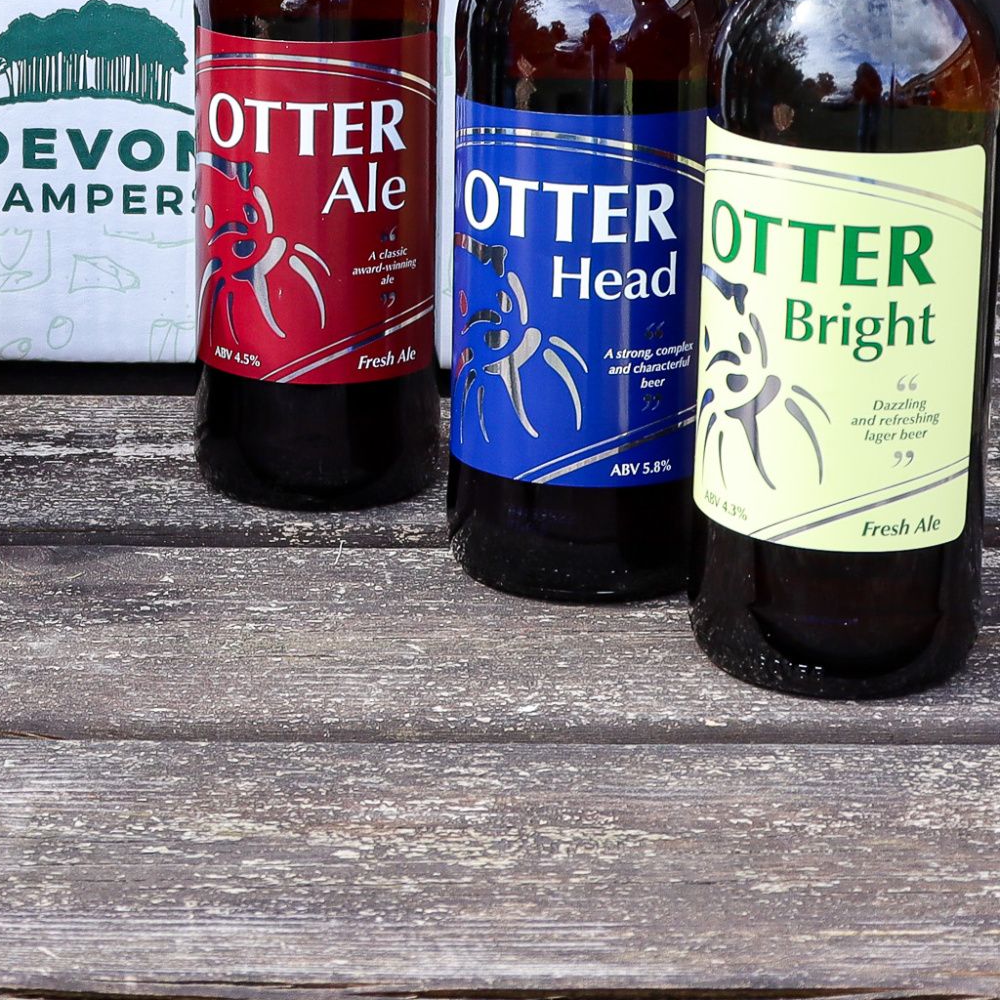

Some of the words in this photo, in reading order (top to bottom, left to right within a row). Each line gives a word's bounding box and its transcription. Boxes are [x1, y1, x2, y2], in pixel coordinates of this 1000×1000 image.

[208, 92, 407, 157] OTTER
[321, 161, 407, 216] Ale
[463, 168, 678, 245] OTTER
[368, 251, 376, 261] A
[379, 246, 408, 260] classic
[711, 199, 936, 287] OTTER
[352, 258, 417, 276] award-winning
[552, 251, 678, 301] Head
[380, 274, 395, 285] ale
[784, 297, 936, 362] Bright
[214, 345, 233, 360] ABV
[234, 351, 261, 367] 4.5%
[357, 350, 394, 370] Fresh
[397, 346, 416, 364] Ale
[603, 348, 614, 359] A
[616, 348, 654, 361] strong,
[656, 340, 694, 357] complex
[608, 362, 631, 375] and
[633, 355, 691, 374] characterful
[640, 377, 666, 389] beer
[873, 398, 927, 412] Dazzling
[851, 414, 876, 426] and
[878, 412, 940, 426] refreshing
[864, 429, 897, 445] lager
[899, 429, 928, 440] beer
[609, 462, 641, 477] ABV
[642, 459, 672, 475] 5.8%
[704, 489, 721, 507] ABV
[722, 500, 748, 521] 4.3%
[861, 518, 910, 537] Fresh
[914, 514, 941, 535] Ale
